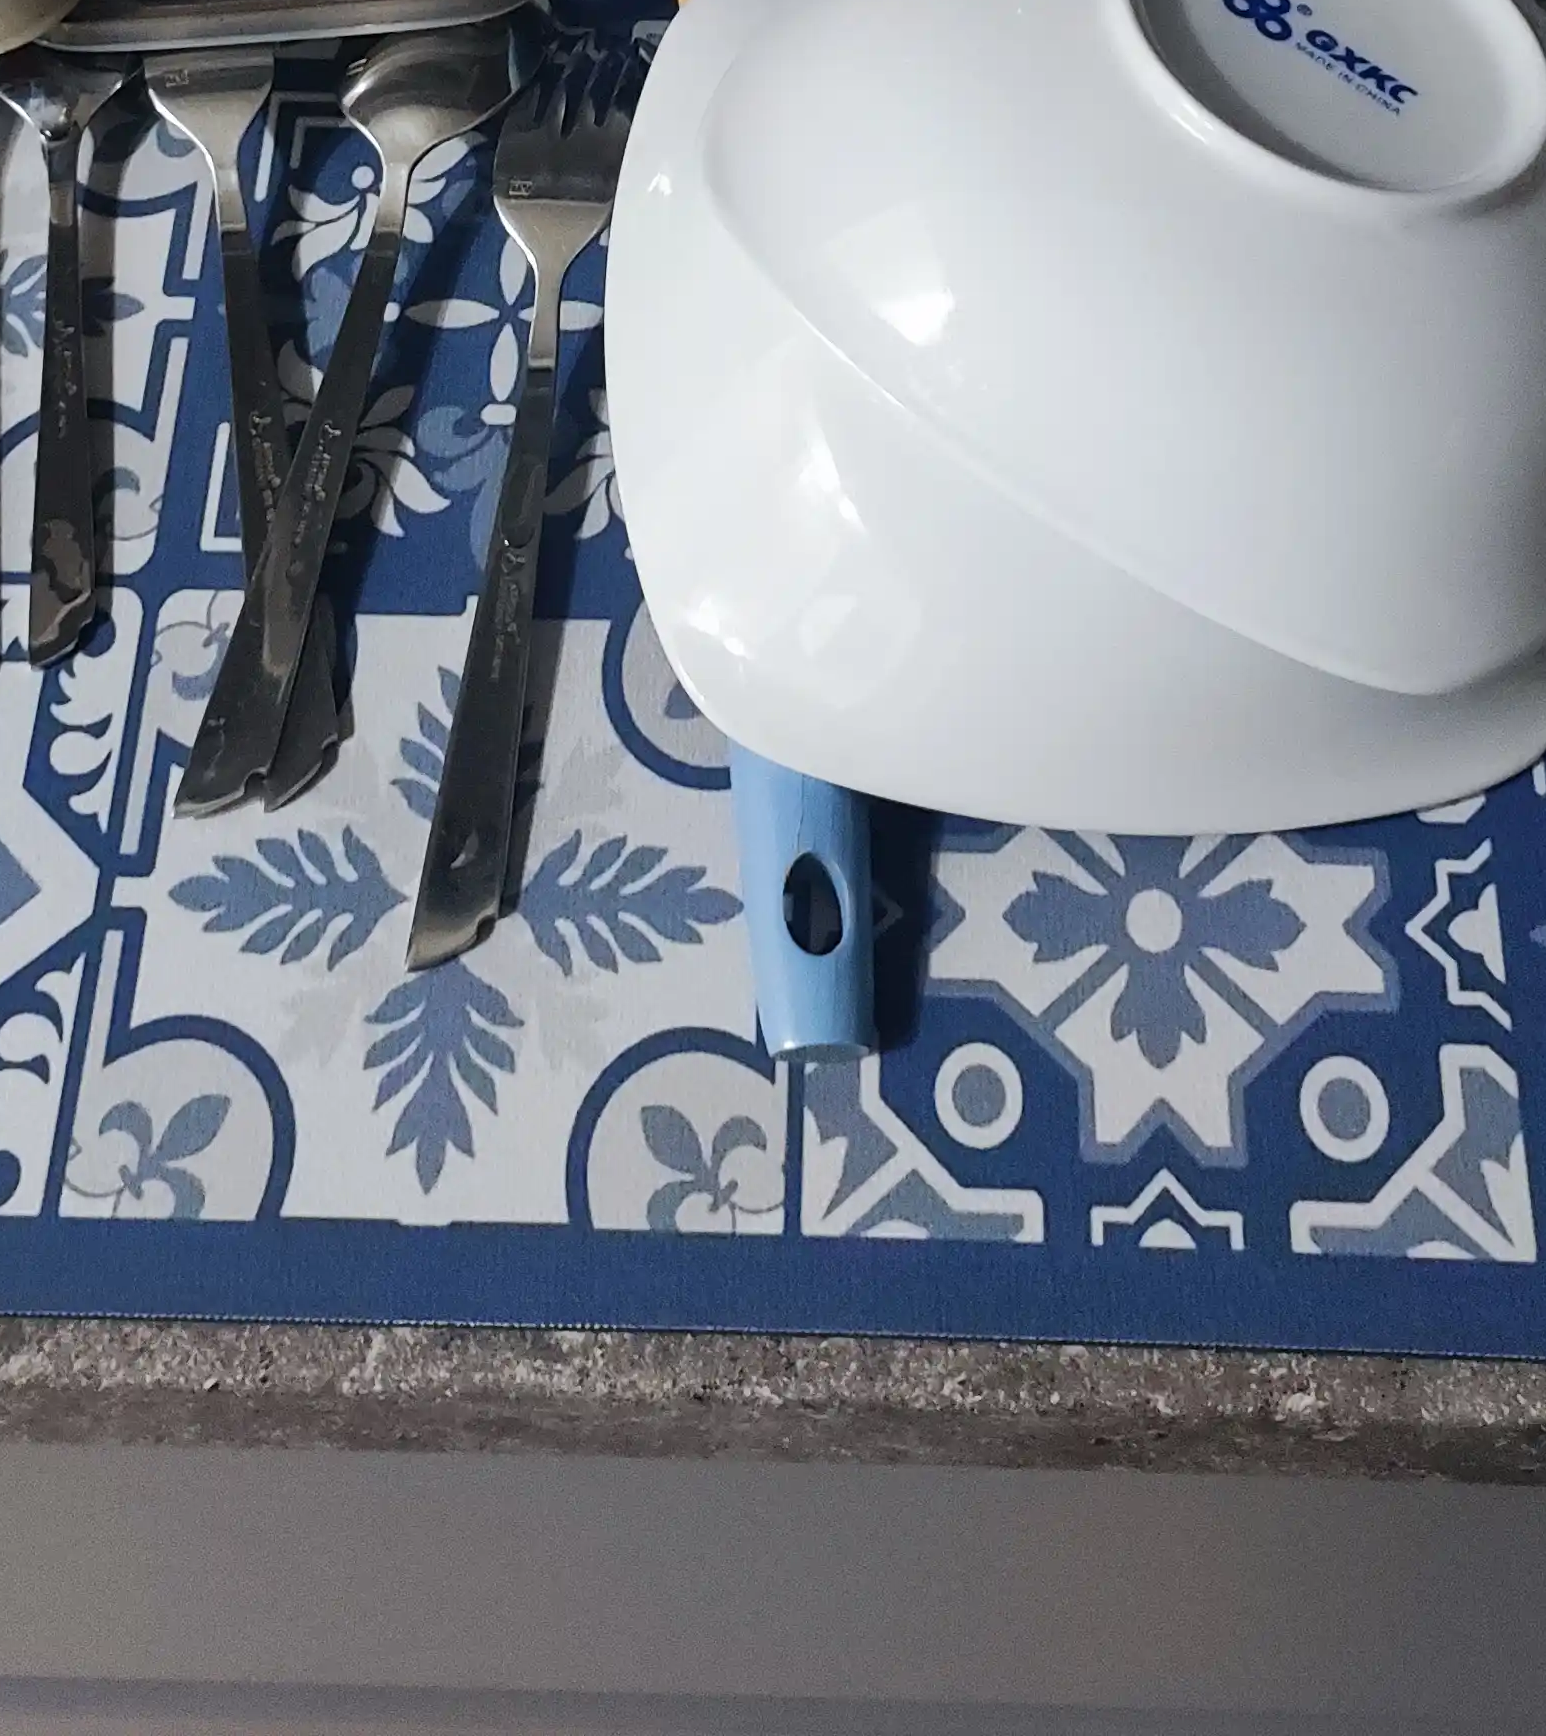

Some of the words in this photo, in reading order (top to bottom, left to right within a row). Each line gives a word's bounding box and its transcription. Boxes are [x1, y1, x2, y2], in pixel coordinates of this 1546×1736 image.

[1295, 41, 1335, 72] MADE
[1337, 71, 1354, 86] IN
[1355, 84, 1401, 116] CHINA
